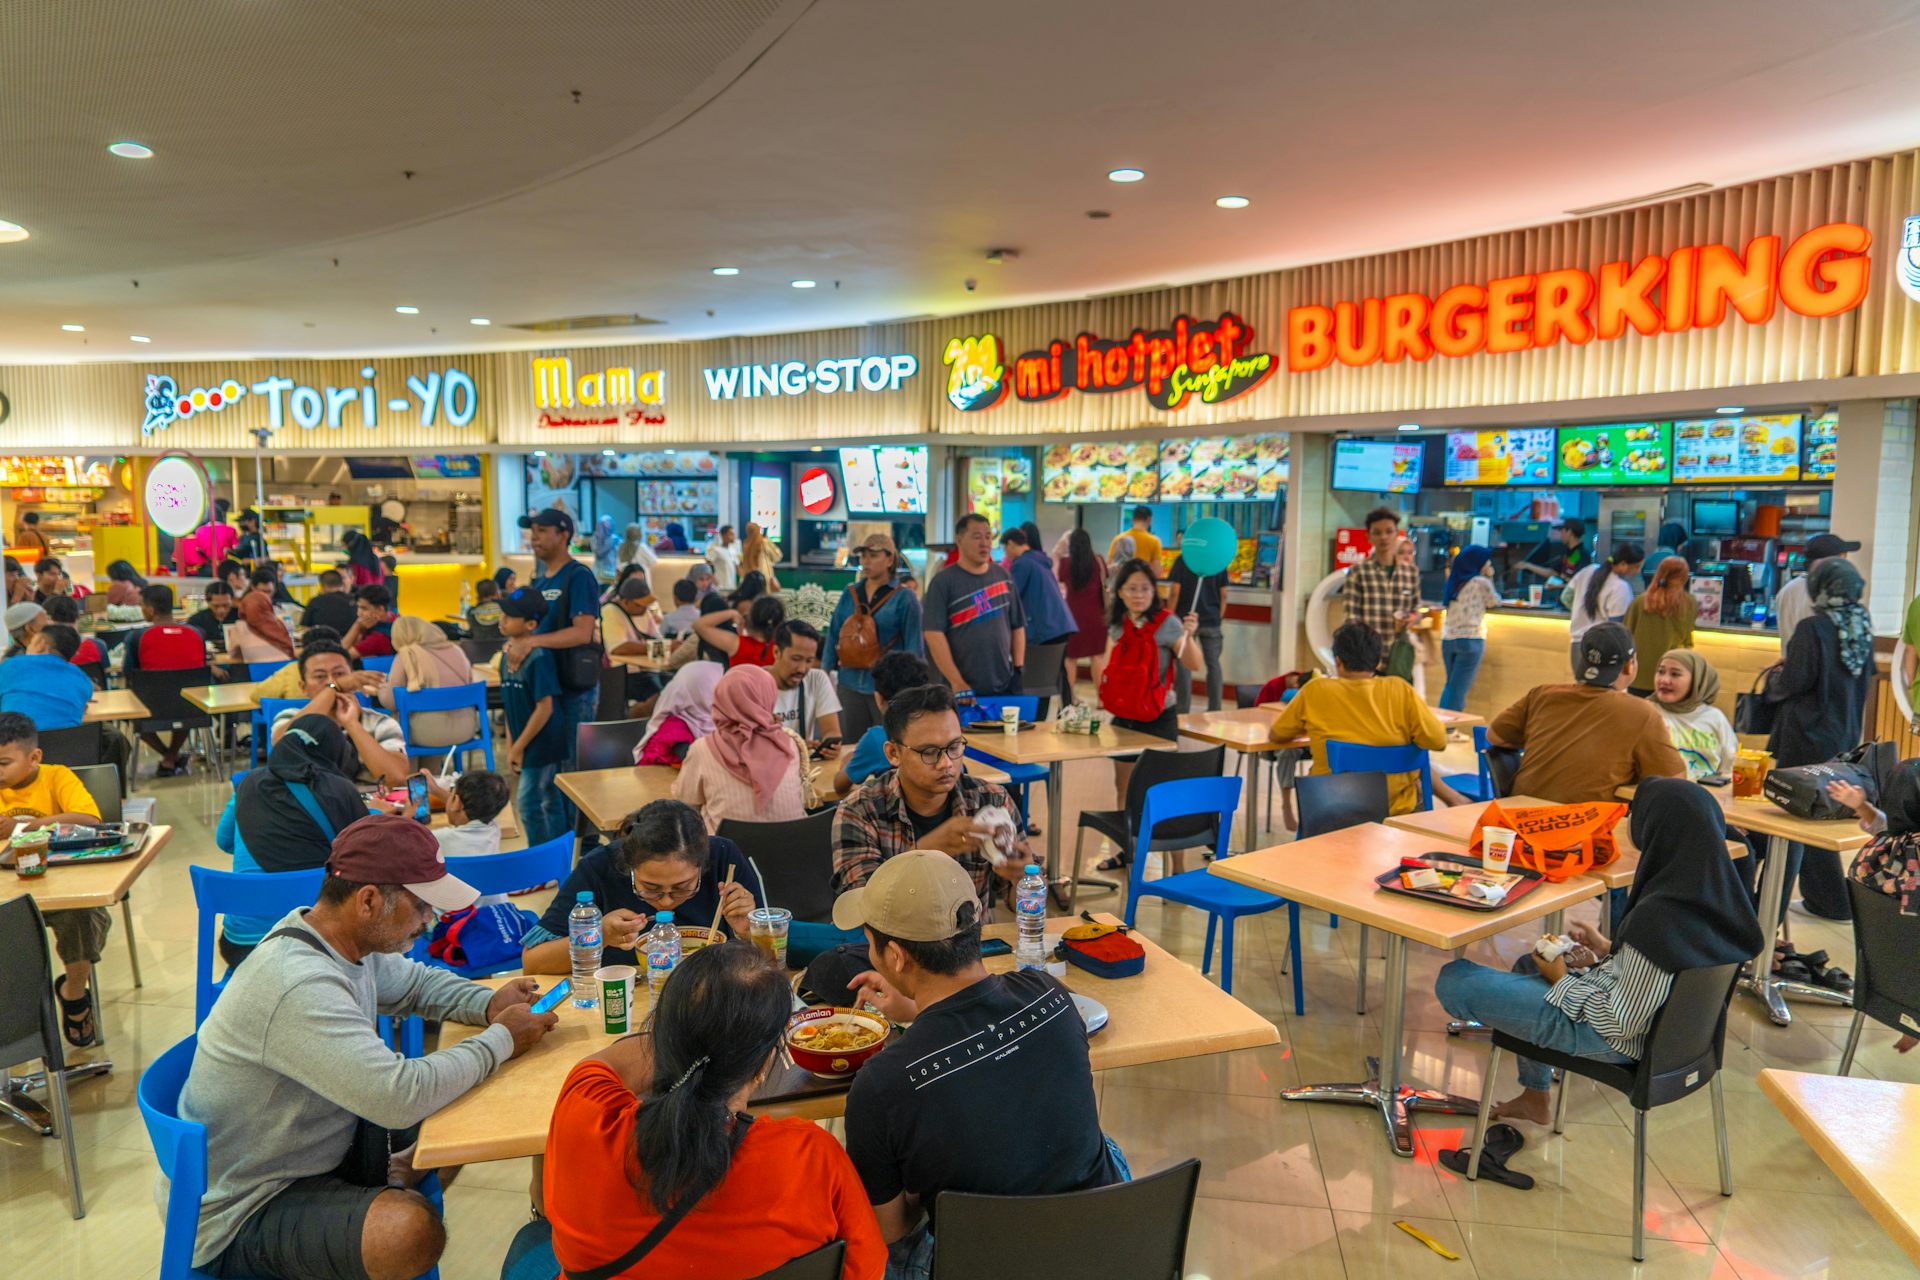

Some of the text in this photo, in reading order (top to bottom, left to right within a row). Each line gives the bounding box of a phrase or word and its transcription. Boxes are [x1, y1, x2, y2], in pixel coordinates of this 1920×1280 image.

[532, 356, 666, 409] Mama
[1015, 341, 1062, 399] mi
[1167, 353, 1272, 408] Singapore
[909, 993, 1065, 1082] LOST IN PARADISE
